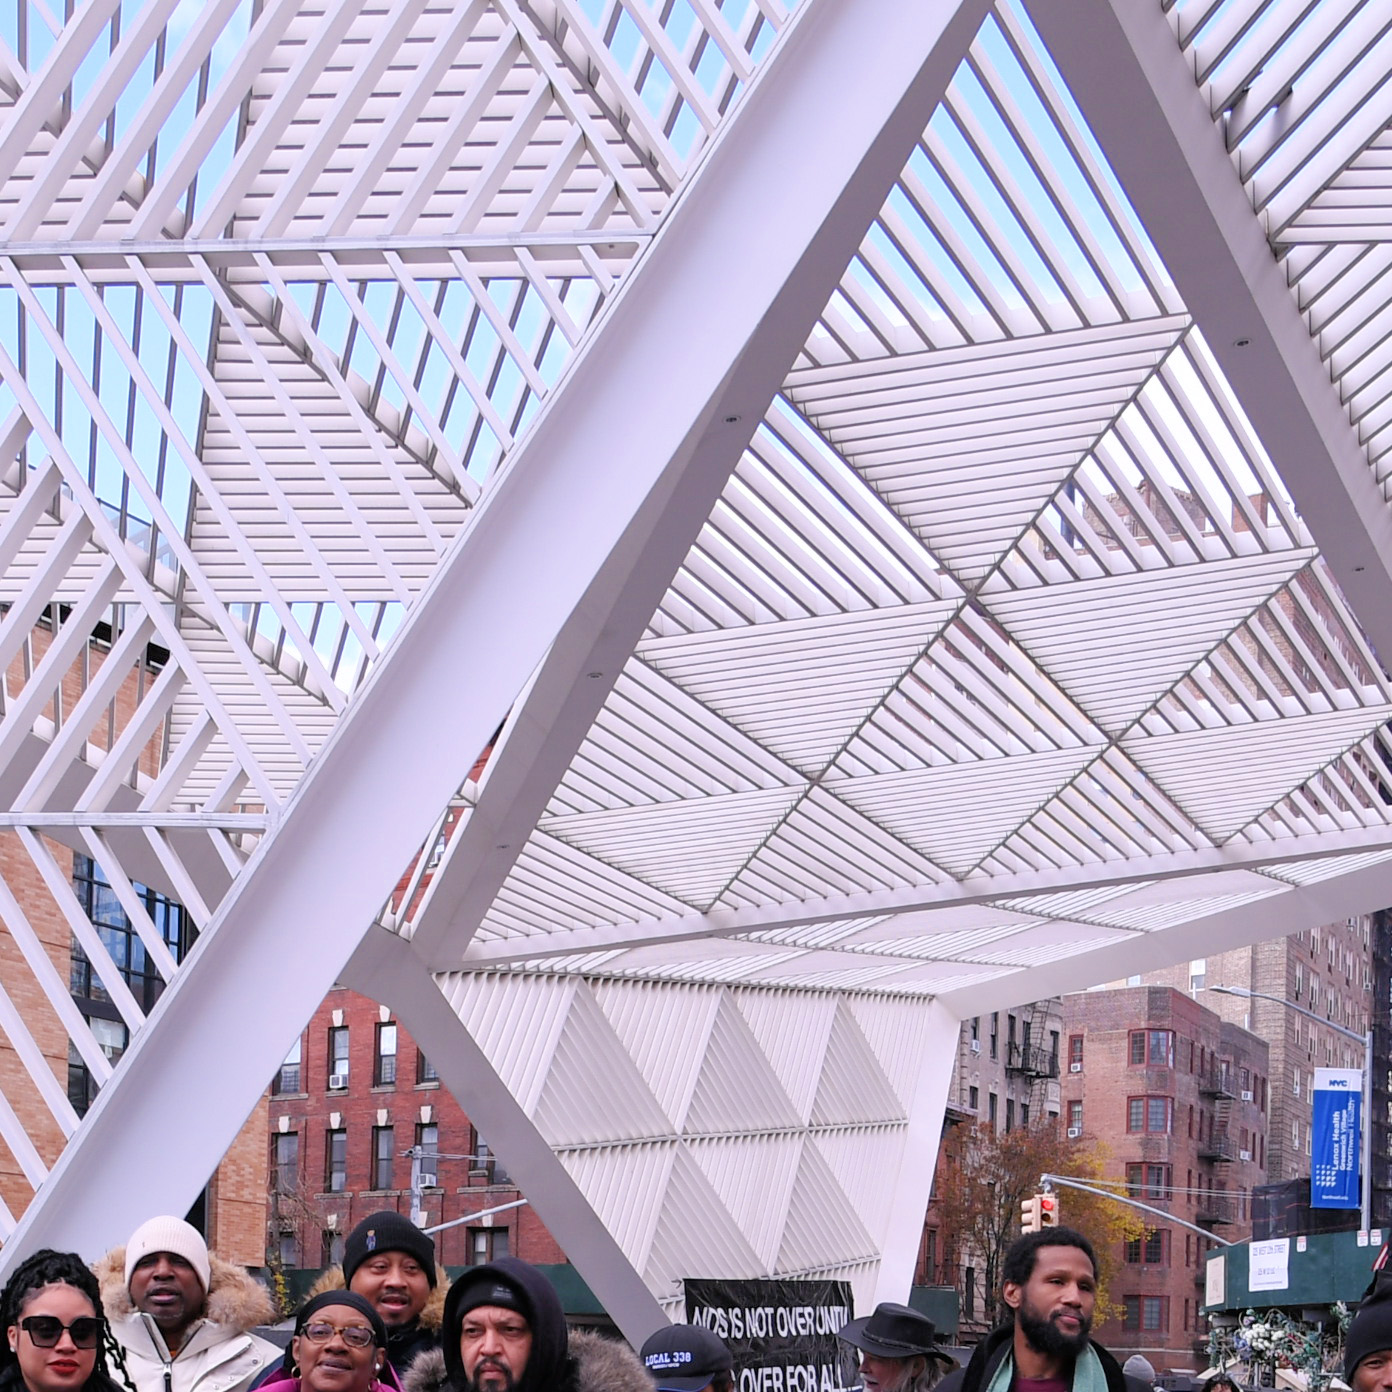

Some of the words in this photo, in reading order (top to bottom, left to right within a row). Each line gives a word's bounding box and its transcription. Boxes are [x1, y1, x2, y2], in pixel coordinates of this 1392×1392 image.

[1332, 1111, 1341, 1140] Health
[1332, 1142, 1340, 1170] Lenox
[693, 1306, 729, 1339] AIDS
[731, 1307, 744, 1339] IS
[746, 1307, 775, 1338] NOT
[777, 1306, 815, 1338] OVER
[645, 1353, 670, 1366] LOCAL
[673, 1352, 691, 1362] 338
